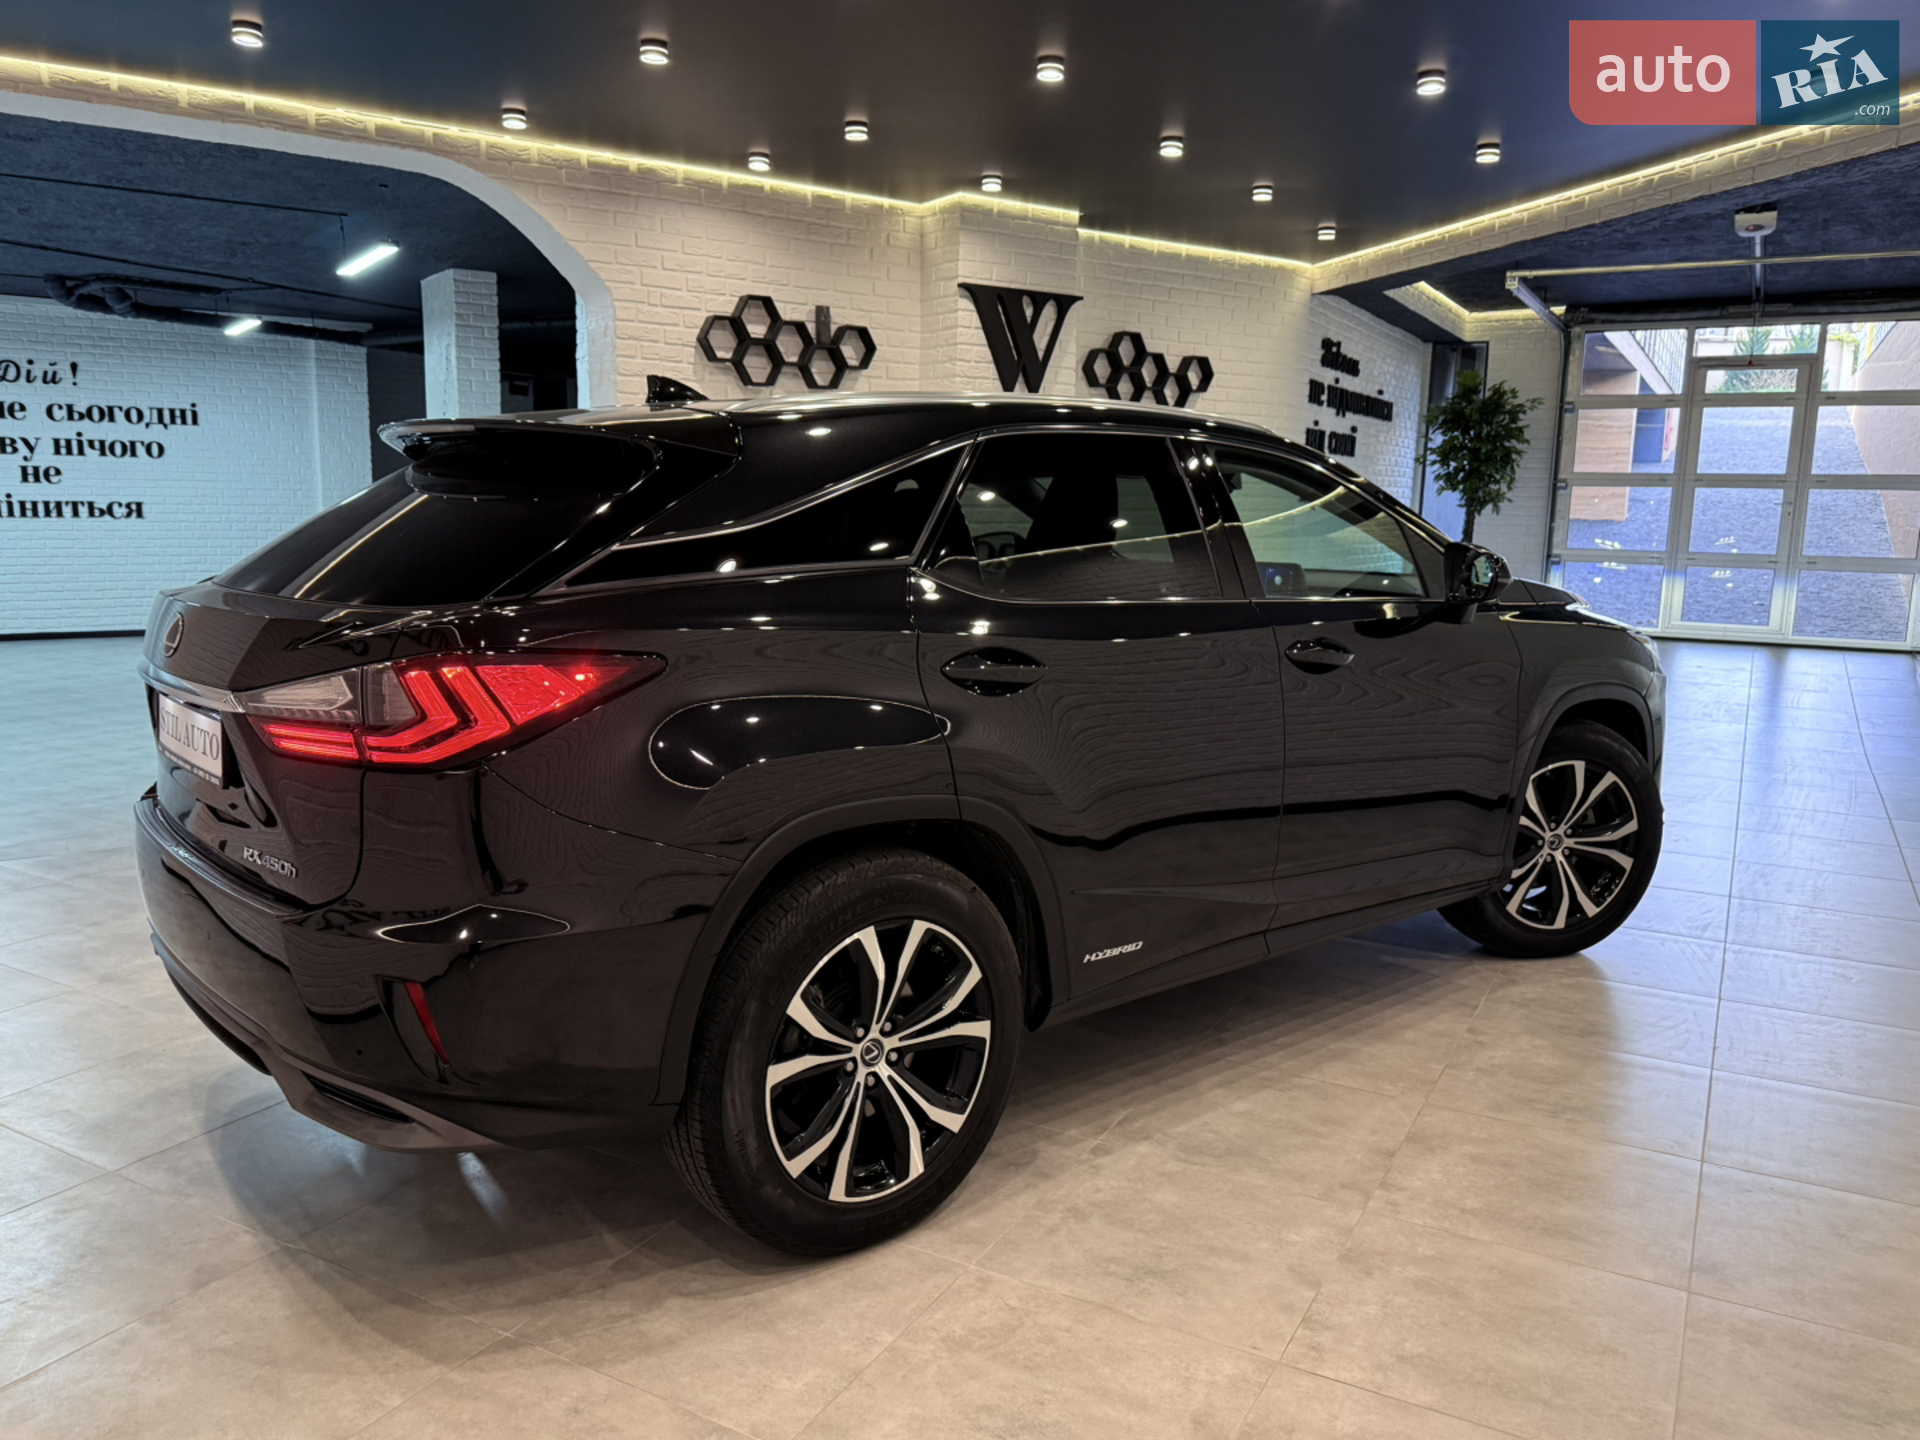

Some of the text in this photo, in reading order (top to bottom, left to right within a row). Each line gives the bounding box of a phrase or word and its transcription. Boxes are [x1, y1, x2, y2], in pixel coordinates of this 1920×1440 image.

[46, 402, 200, 431] сьогодні
[52, 431, 165, 459] нічого
[19, 464, 62, 484] не
[0, 492, 146, 519] іниться
[182, 720, 220, 761] AUTO
[243, 846, 297, 878] RX 450h
[1083, 940, 1143, 963] HYBRID
